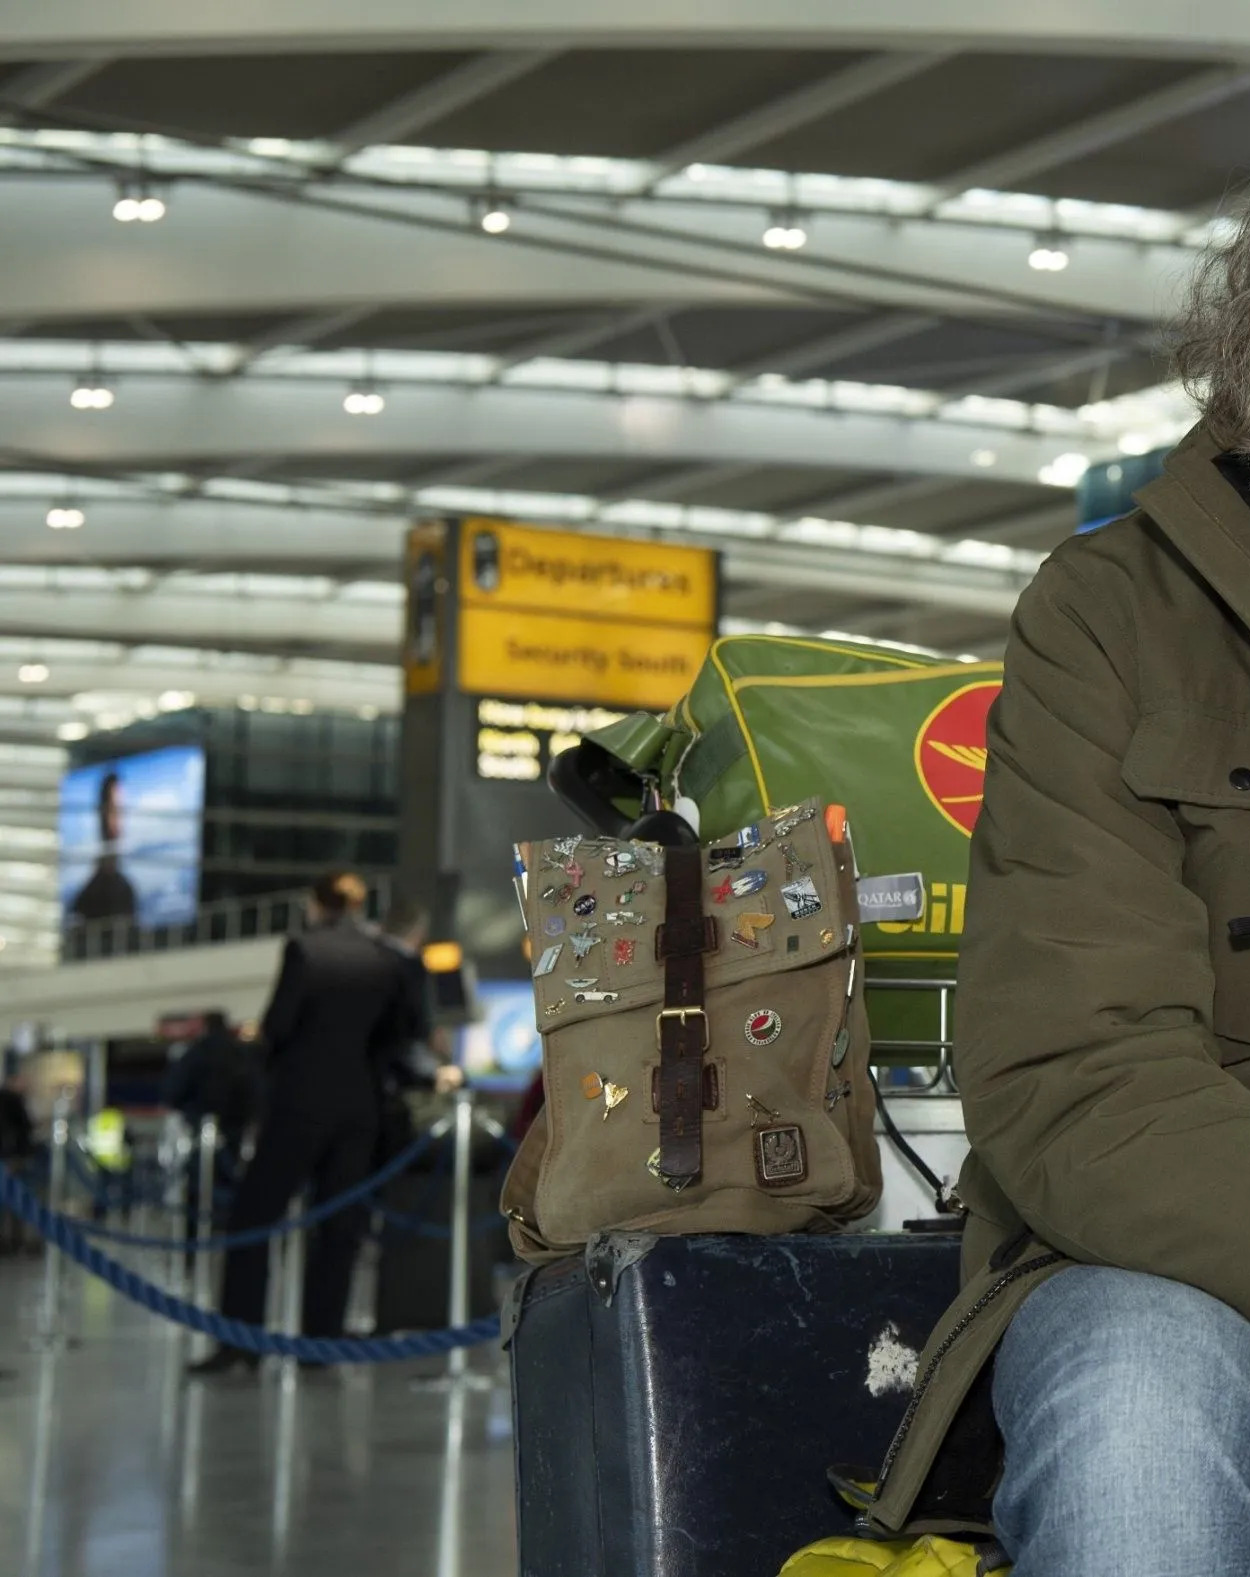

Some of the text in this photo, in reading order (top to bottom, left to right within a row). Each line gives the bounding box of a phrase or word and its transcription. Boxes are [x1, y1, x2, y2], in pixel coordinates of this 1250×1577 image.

[506, 547, 691, 594] Departures
[507, 637, 610, 674] Security
[858, 891, 902, 907] QATAR
